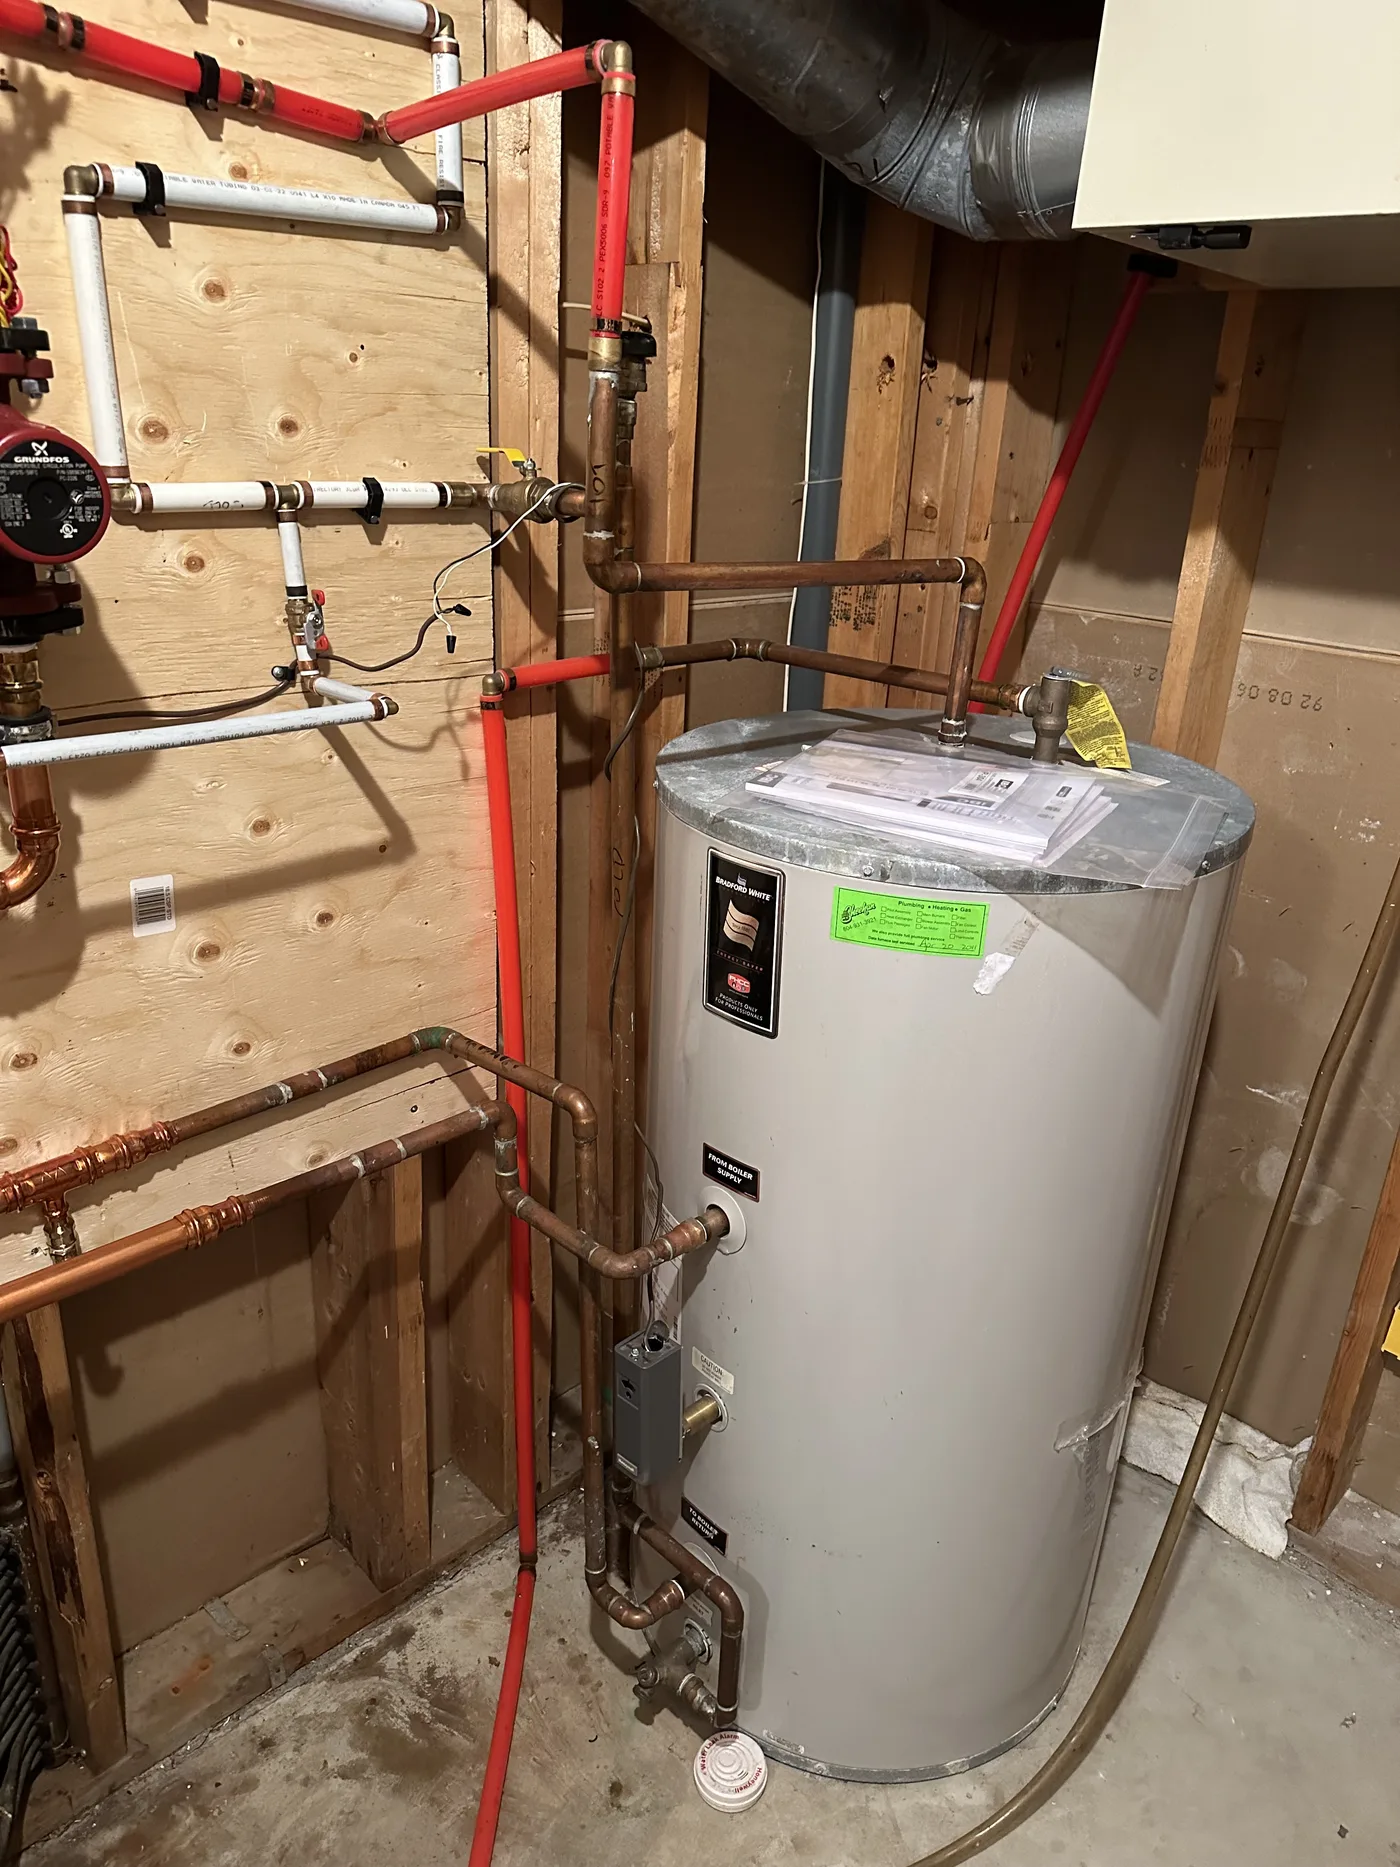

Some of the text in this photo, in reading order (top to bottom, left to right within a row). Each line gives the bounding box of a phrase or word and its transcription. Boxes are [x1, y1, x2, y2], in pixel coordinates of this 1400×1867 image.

[605, 115, 614, 155] POTABLE
[191, 177, 216, 186] WATER
[219, 181, 247, 190] TUBING
[1237, 683, 1260, 700] 06
[1268, 688, 1293, 706] 08
[1300, 694, 1323, 712] 92
[715, 876, 748, 893] BRADFORD
[748, 887, 771, 901] WHITE
[898, 900, 925, 909] Plumbing
[932, 904, 954, 913] Heating
[715, 997, 763, 1021] FOR PROFESSIONALS
[719, 993, 743, 1008] PRODUCTS
[744, 1003, 758, 1013] ONLY
[708, 1153, 753, 1180] FROM BOILER
[717, 1167, 742, 1184] SUPPLY
[700, 1354, 723, 1376] CAUTION
[697, 1515, 719, 1535] BOILER
[706, 1737, 720, 1750] Leak
[719, 1733, 740, 1741] Alarm
[734, 1767, 763, 1794] Honeywell
